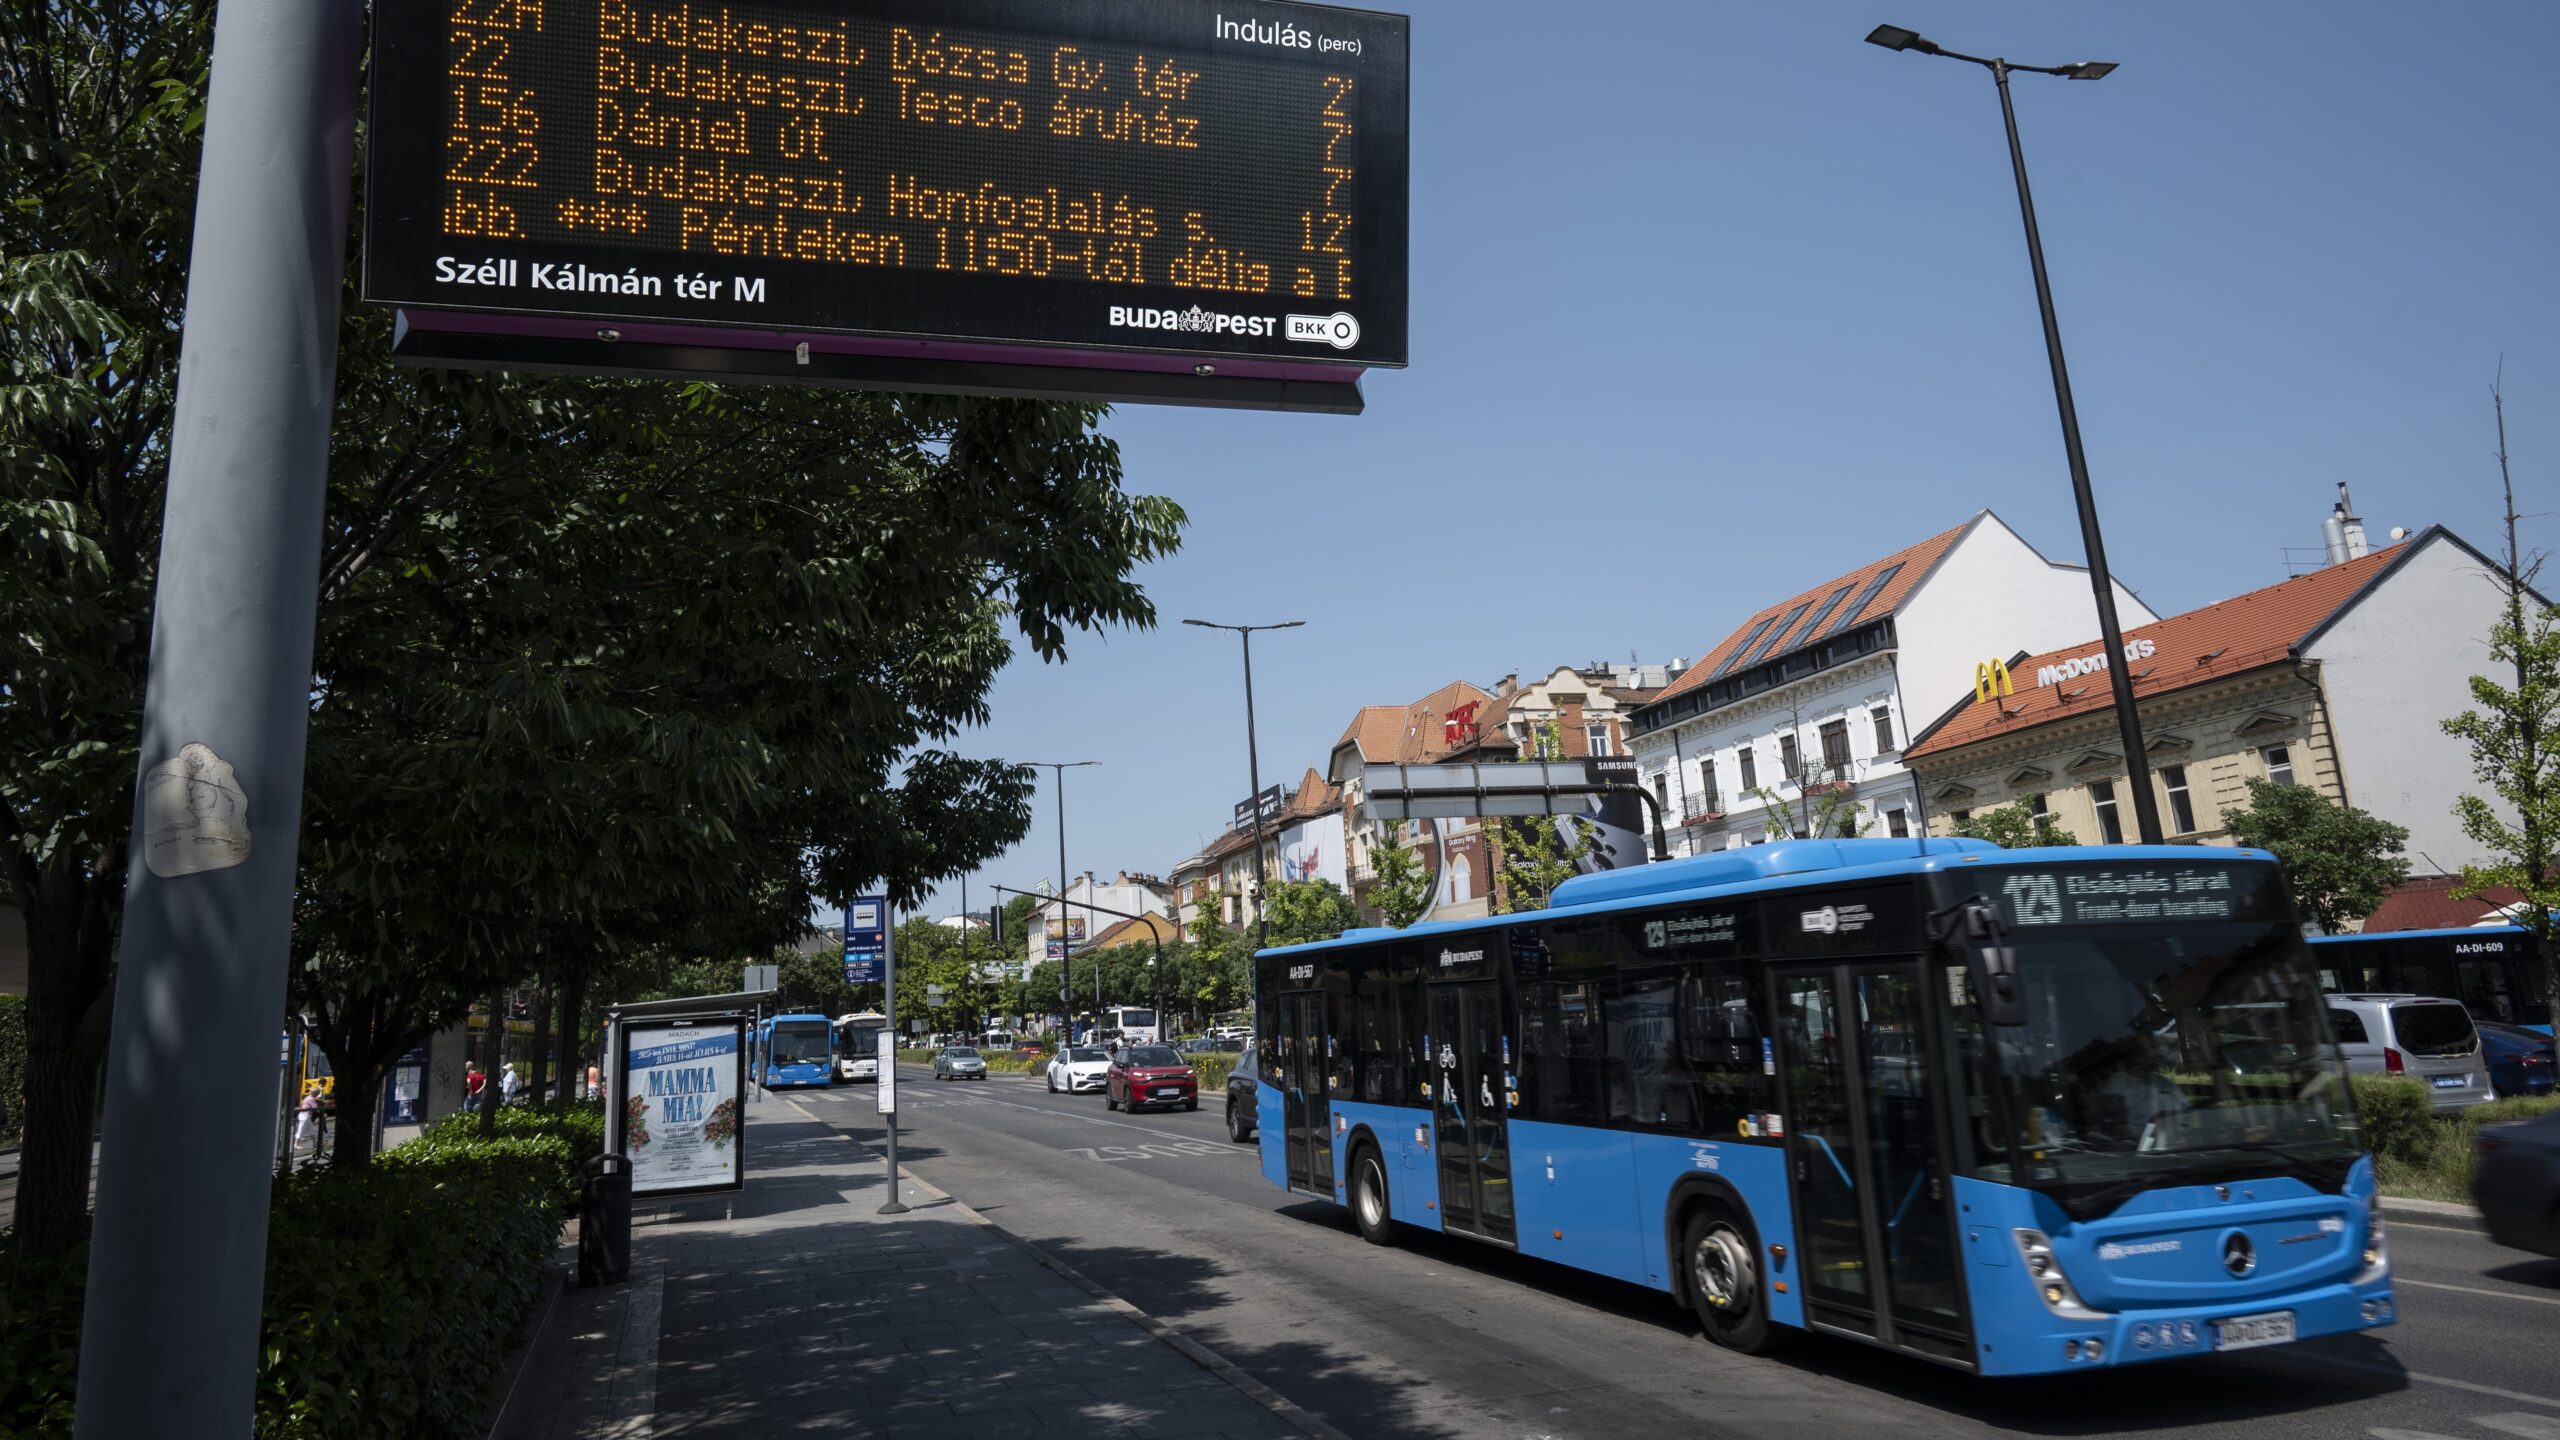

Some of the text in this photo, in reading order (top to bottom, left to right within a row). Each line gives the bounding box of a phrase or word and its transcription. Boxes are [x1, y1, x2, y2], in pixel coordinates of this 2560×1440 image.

[599, 0, 865, 66] Budakeszi,
[892, 27, 1029, 84] Dózsa
[1054, 46, 1108, 91] Gy.
[1134, 54, 1200, 100] tér
[1216, 14, 1362, 56] Indulás (perc)
[449, 31, 1199, 148] 22 Budakeszi, Tesco áruház
[452, 84, 829, 161] 156 Dániel út
[446, 136, 540, 187] 222
[596, 148, 863, 213] Budakeszi,
[888, 174, 1158, 237] Honfoglalás
[682, 206, 904, 266] Pénteken
[1170, 246, 1270, 293] délig
[1293, 266, 1315, 297] a
[435, 256, 766, 303] Széll Kálmán tér M
[1294, 322, 1326, 335] BKK
[2037, 639, 2156, 688] McDond's
[1453, 950, 1484, 962] BUDAPEST
[2455, 941, 2504, 954] AA-DI-609
[1289, 964, 1314, 980] AA-DI-567
[648, 1066, 717, 1097] MAMMA
[662, 1094, 703, 1123] MIA!
